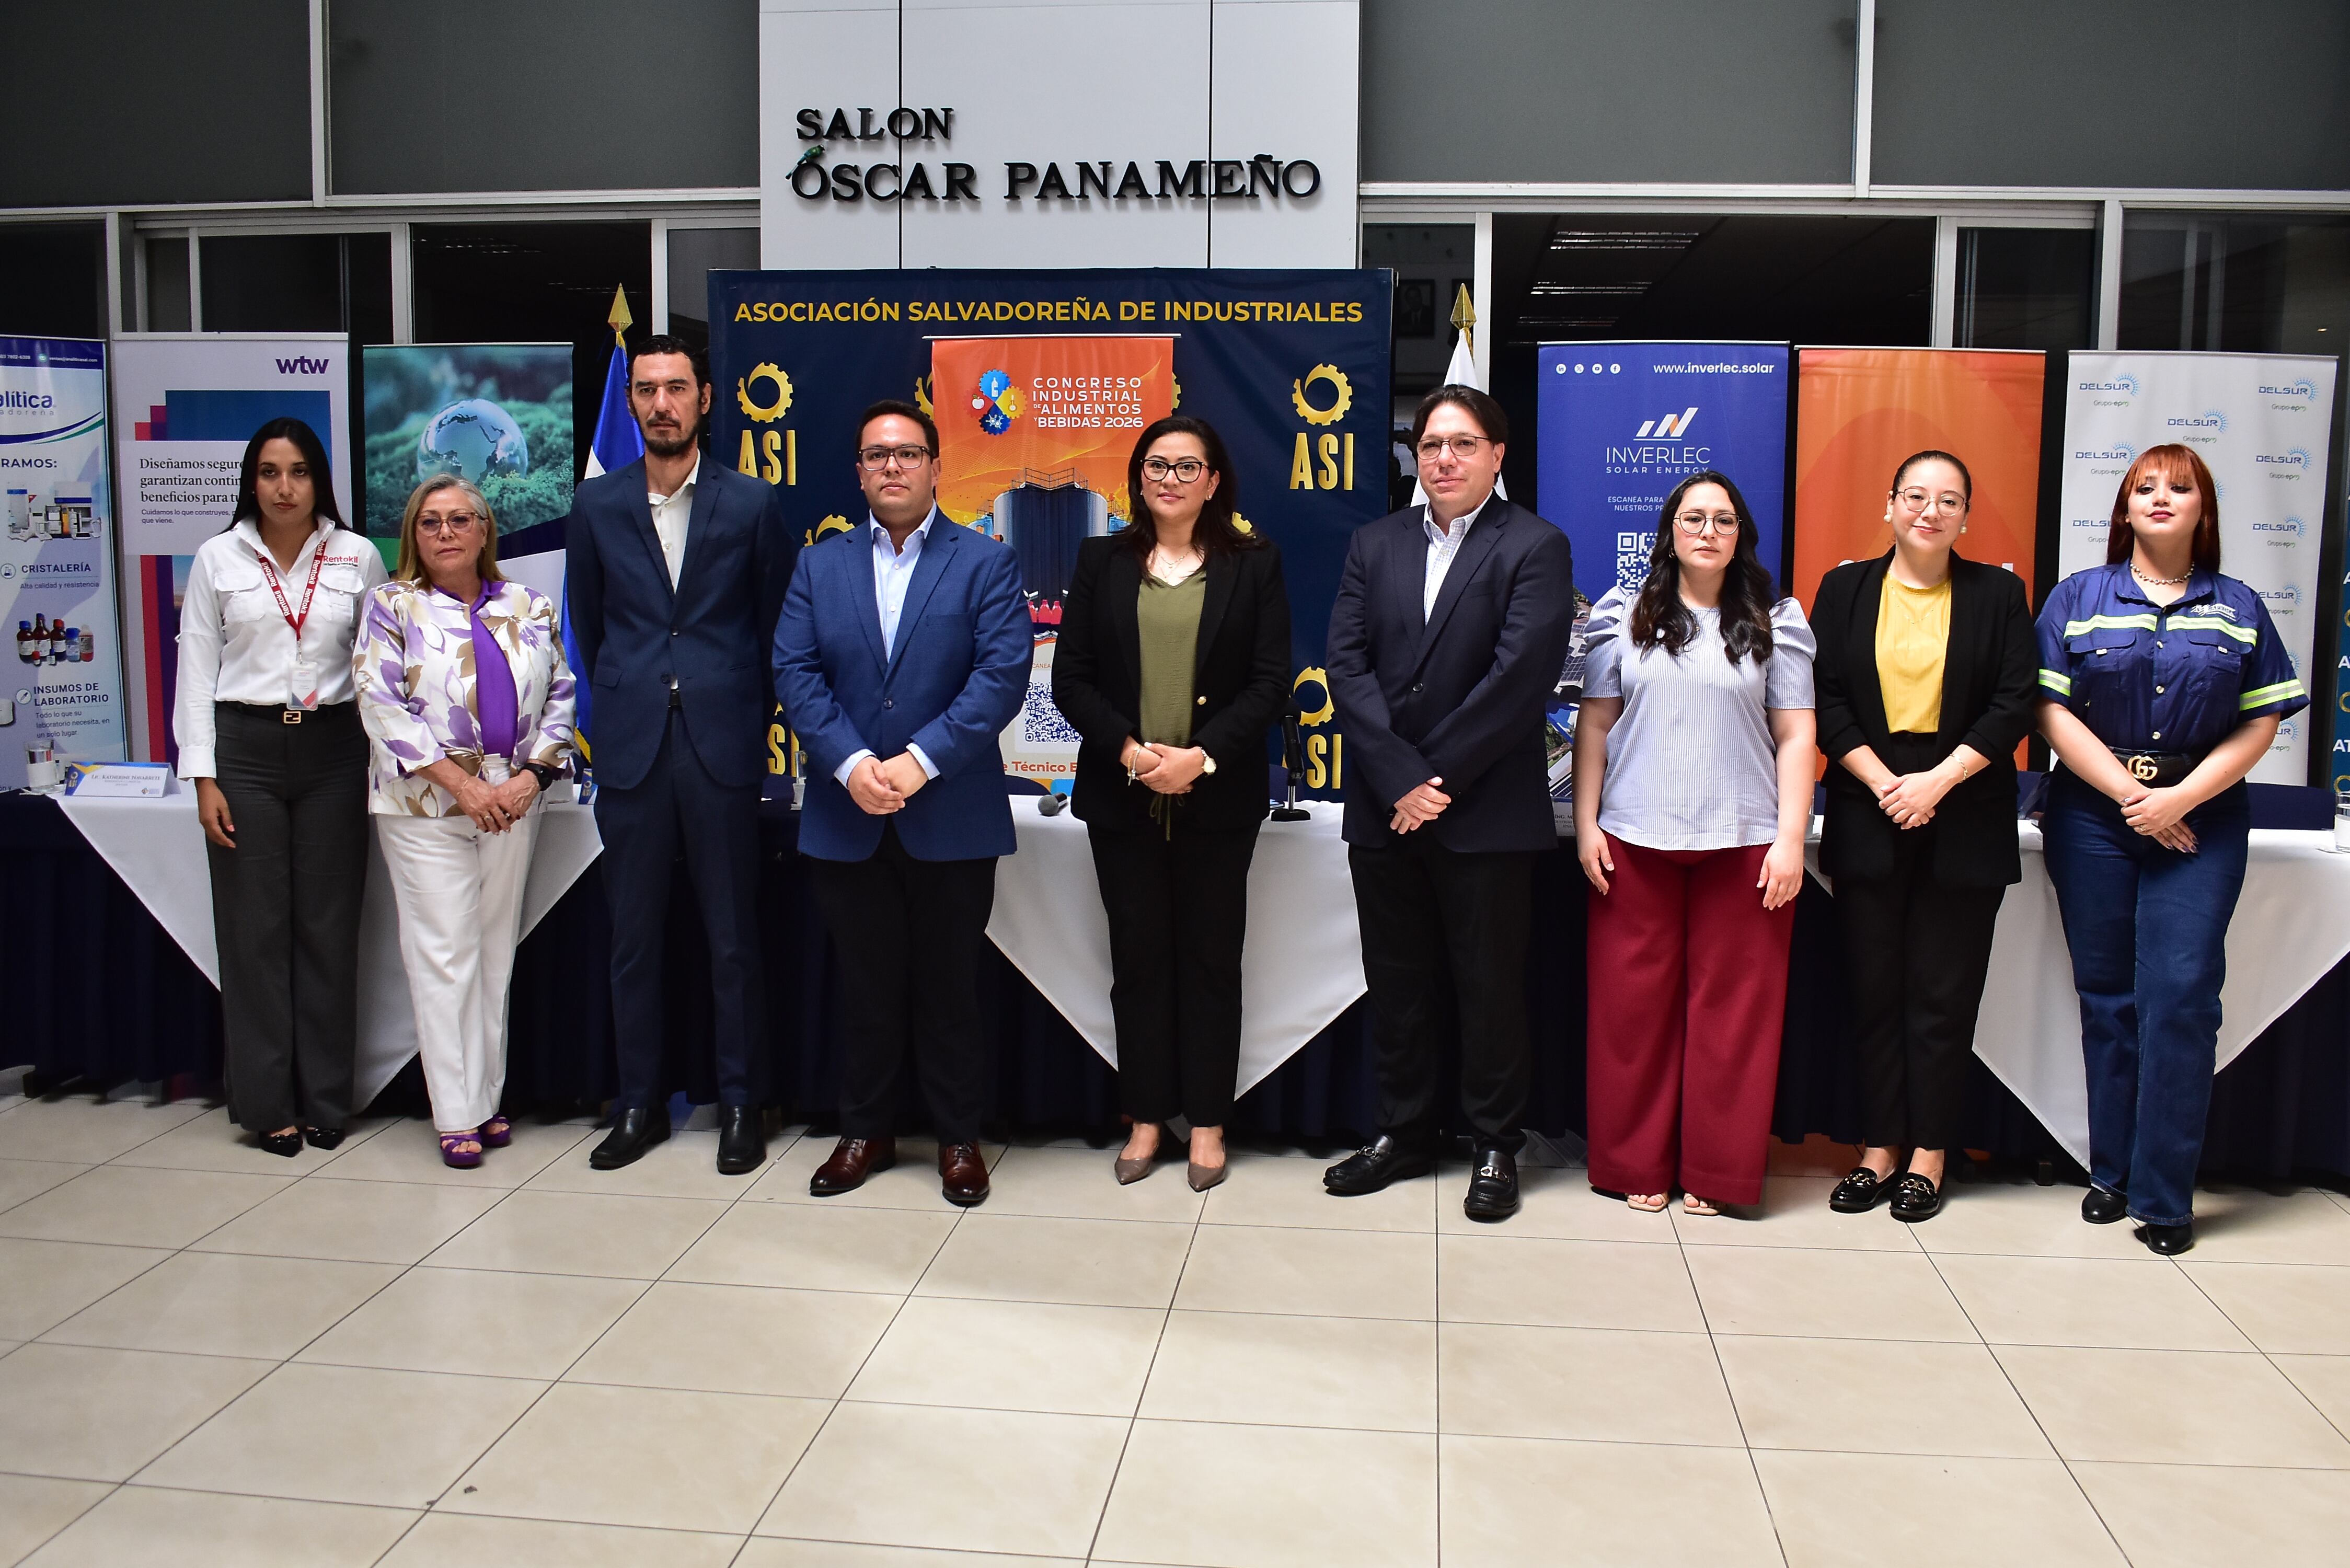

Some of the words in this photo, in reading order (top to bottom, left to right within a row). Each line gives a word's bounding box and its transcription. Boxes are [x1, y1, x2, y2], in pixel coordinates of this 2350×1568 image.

[796, 107, 954, 140] SALON
[1004, 154, 1321, 199] PANAMEÑO
[734, 297, 900, 322] ASOCIACIÓN
[908, 296, 1111, 321] SALVADOREÑA
[1120, 301, 1156, 321] DE
[1165, 301, 1363, 322] INDUSTRIALES
[275, 355, 330, 374] wtw
[1653, 362, 1775, 374] www.inverlec.solar
[1033, 377, 1142, 388] CONGRESO
[1033, 390, 1142, 401] INDUSTRIAL
[2259, 386, 2308, 395] DELSUR
[1041, 403, 1142, 414] ALIMENTOS
[1038, 417, 1101, 428] BEBIDAS
[1104, 417, 1144, 428] 2026
[738, 430, 797, 486] ASI
[1289, 432, 1354, 491] ASI
[1606, 447, 1711, 464] INVERLEC
[2256, 455, 2302, 464] DELSUR
[1, 458, 57, 468] RAMOS:
[140, 458, 205, 469] Diseñamos
[141, 475, 202, 489] garantizan
[204, 475, 242, 486] contin
[141, 491, 201, 502] beneficios
[202, 495, 228, 505] para
[316, 540, 327, 556] tokil
[21, 562, 91, 573] CRISTALERÍA
[261, 561, 278, 587] Rentokil
[308, 559, 320, 585] Rentokil
[274, 590, 291, 616] Rentokil
[300, 588, 313, 614] Rentokil
[33, 684, 82, 694] INSUMOS
[86, 683, 99, 691] DE
[34, 694, 109, 706] LABORATORIO
[36, 719, 71, 729] laboratorio
[767, 723, 800, 777] SI
[1011, 761, 1066, 772] Técnico
[1070, 762, 1077, 773] E
[1282, 734, 1342, 789] SI
